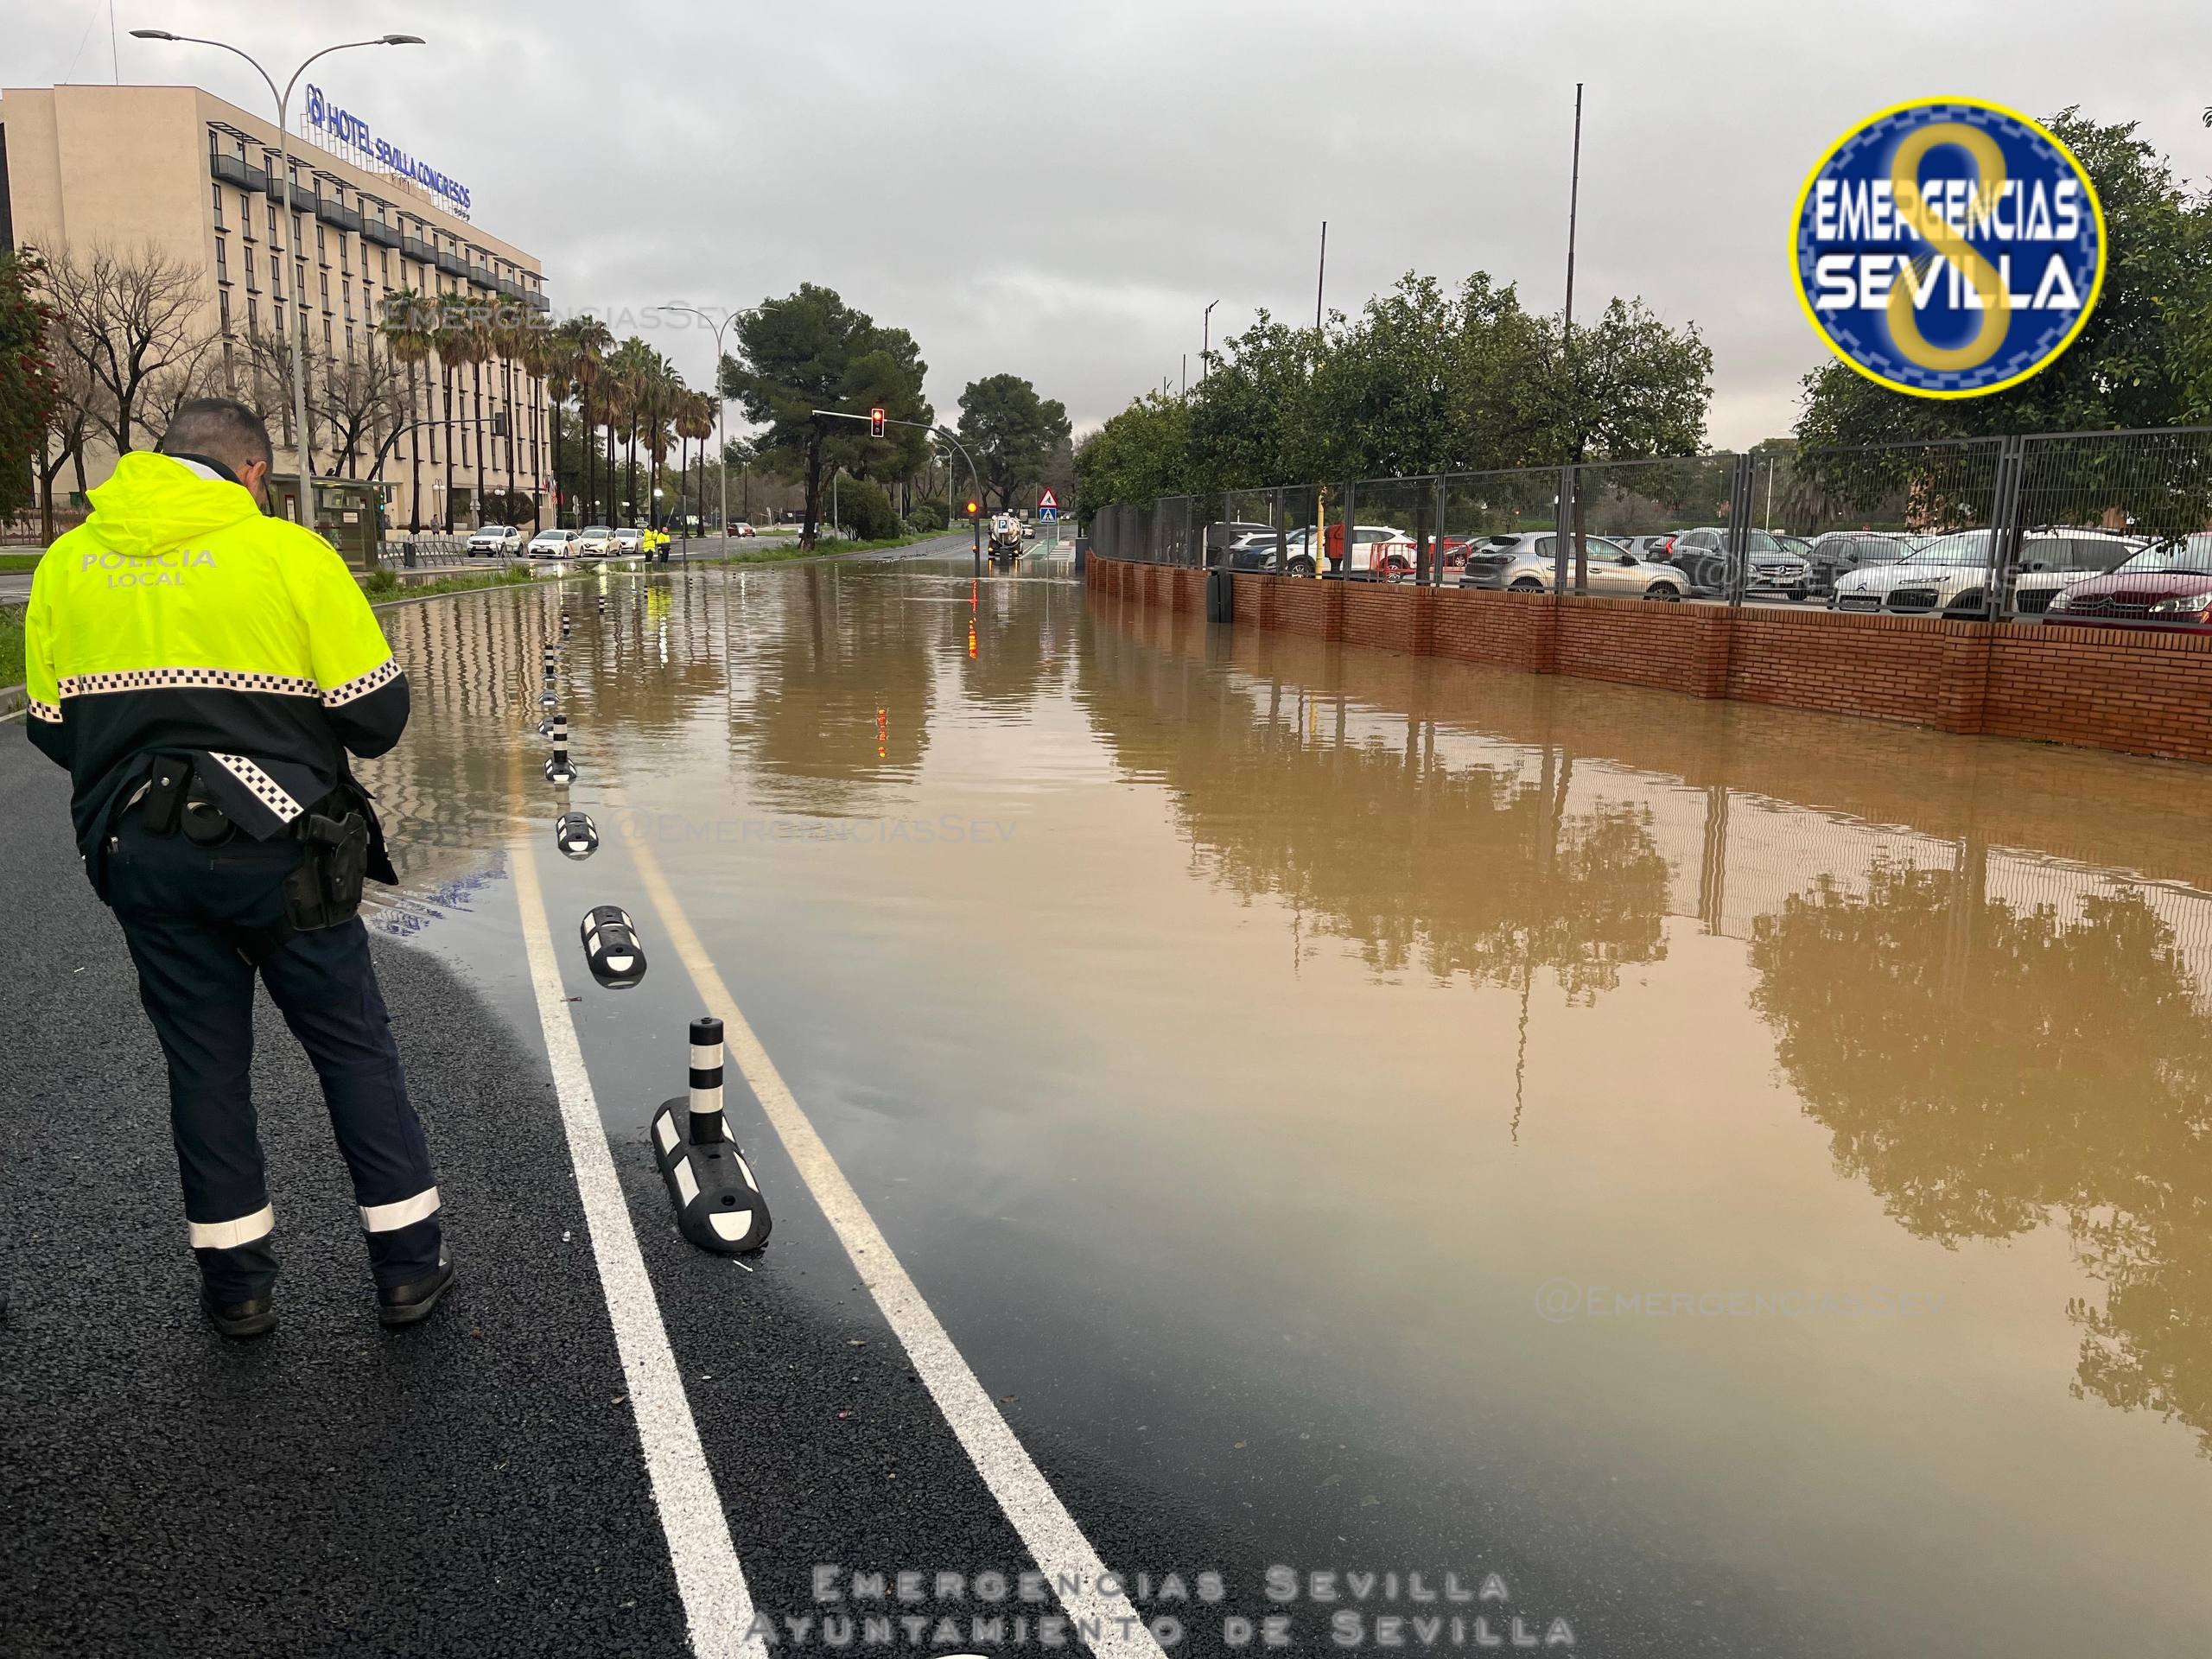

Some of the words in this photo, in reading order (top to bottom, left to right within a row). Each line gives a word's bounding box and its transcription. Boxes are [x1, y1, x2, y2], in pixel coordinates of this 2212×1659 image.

[327, 103, 374, 156] HOTEL
[376, 137, 416, 179] SEVILLA
[417, 162, 471, 209] CONGRESOS
[107, 572, 186, 588] LOCAL
